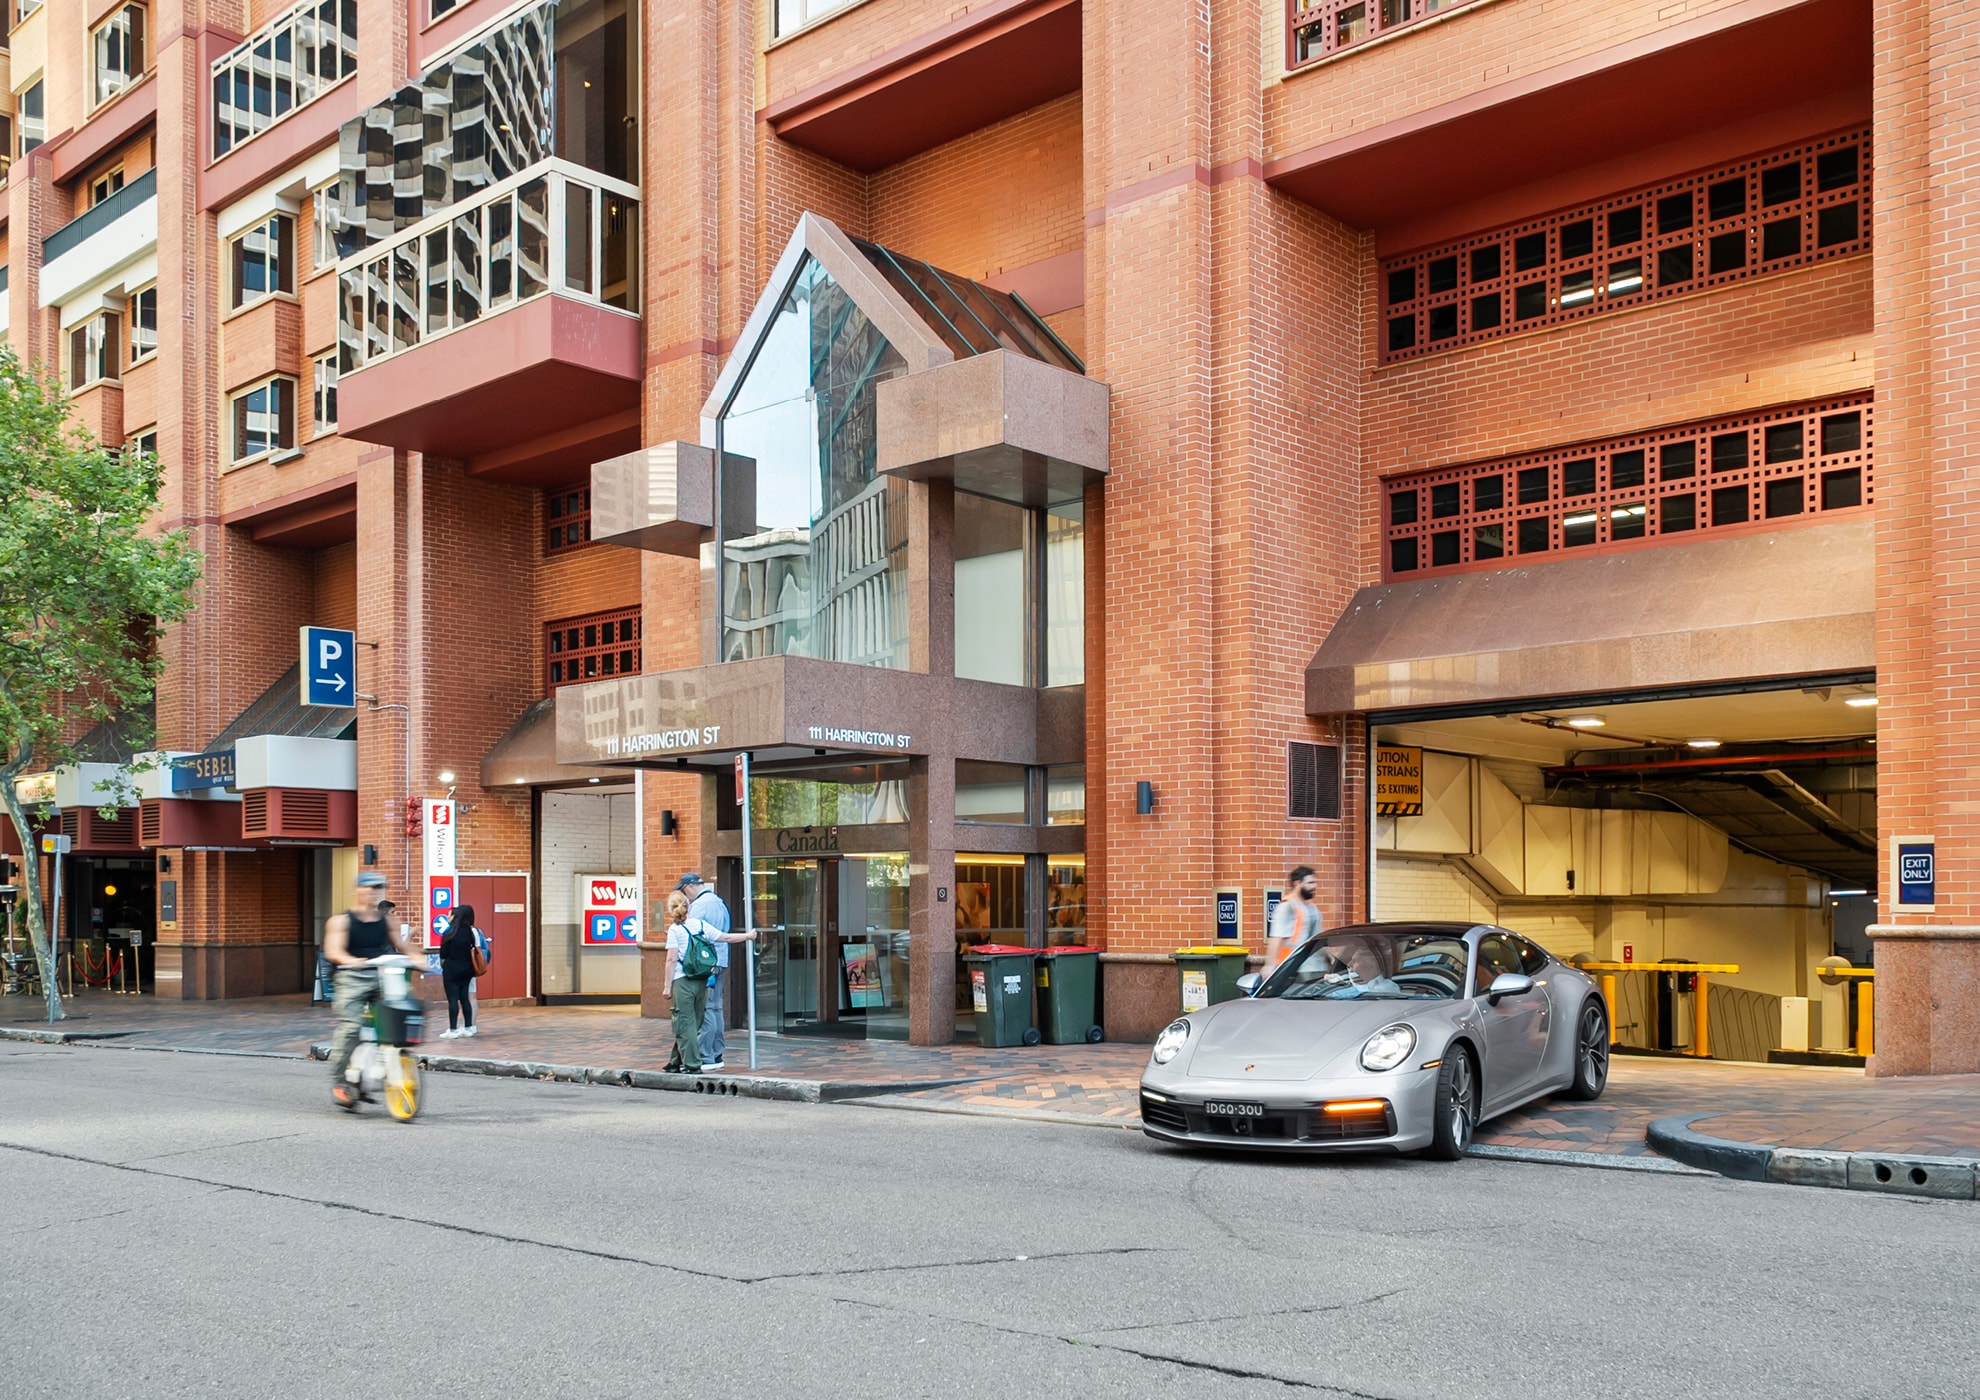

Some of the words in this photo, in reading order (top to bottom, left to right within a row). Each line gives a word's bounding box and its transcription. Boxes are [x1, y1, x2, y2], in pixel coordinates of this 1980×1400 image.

[320, 639, 342, 669] P
[606, 737, 619, 754] 111
[622, 728, 699, 753] HARRINGTON
[703, 726, 720, 745] ST
[809, 726, 822, 740] 111
[825, 728, 894, 746] HARRINGTON
[897, 735, 911, 748] ST
[1377, 752, 1409, 763] UTION
[196, 756, 235, 778] SEBEL
[1377, 766, 1419, 777] STRIANS
[1378, 784, 1386, 794] ES
[1389, 784, 1419, 794] EXITING
[437, 828, 445, 868] Wilson
[776, 828, 839, 852] Canada
[1906, 859, 1928, 868] EXIT
[1904, 870, 1930, 879] ONLY
[435, 890, 448, 905] P
[618, 887, 637, 899] Wi
[597, 919, 611, 936] P
